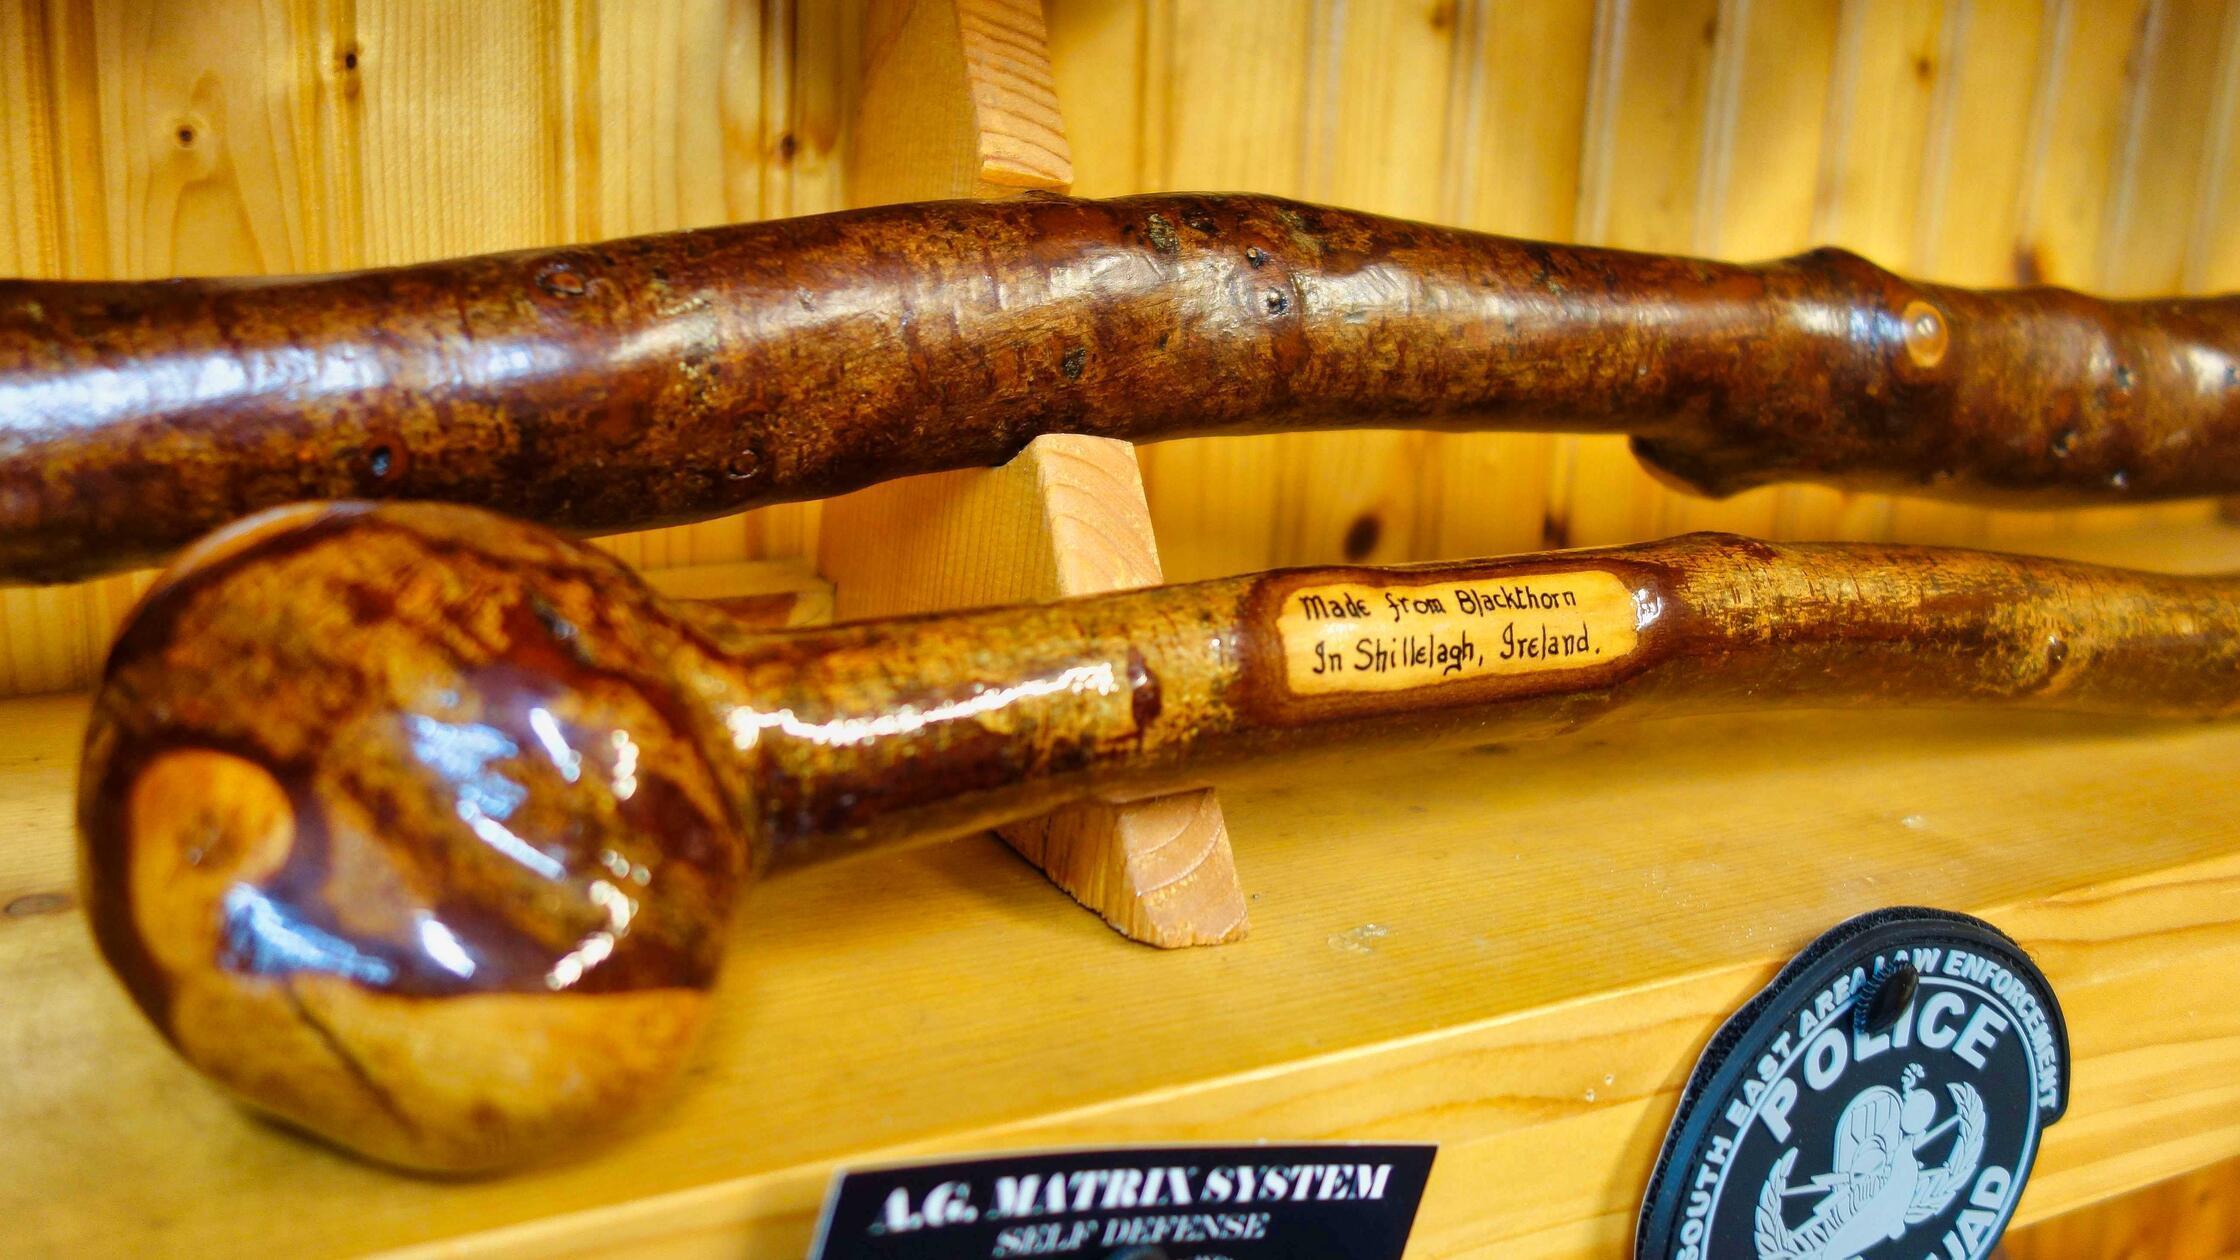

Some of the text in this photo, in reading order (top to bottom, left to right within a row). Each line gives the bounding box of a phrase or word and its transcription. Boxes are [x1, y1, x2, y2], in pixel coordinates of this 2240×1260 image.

[1299, 585, 1577, 622] Made from Blackthorn
[1312, 622, 1601, 677] In Shillelagh, Ireland.
[1725, 1032, 1792, 1128] EAST
[1799, 966, 1867, 1038] AREA
[1942, 949, 2058, 1108] ENFORCEMENT
[1759, 990, 2009, 1143] POLICE
[868, 1163, 1395, 1233] A.G. MATRIX SYSTEM
[992, 1212, 1271, 1258] SELF DEFENSE
